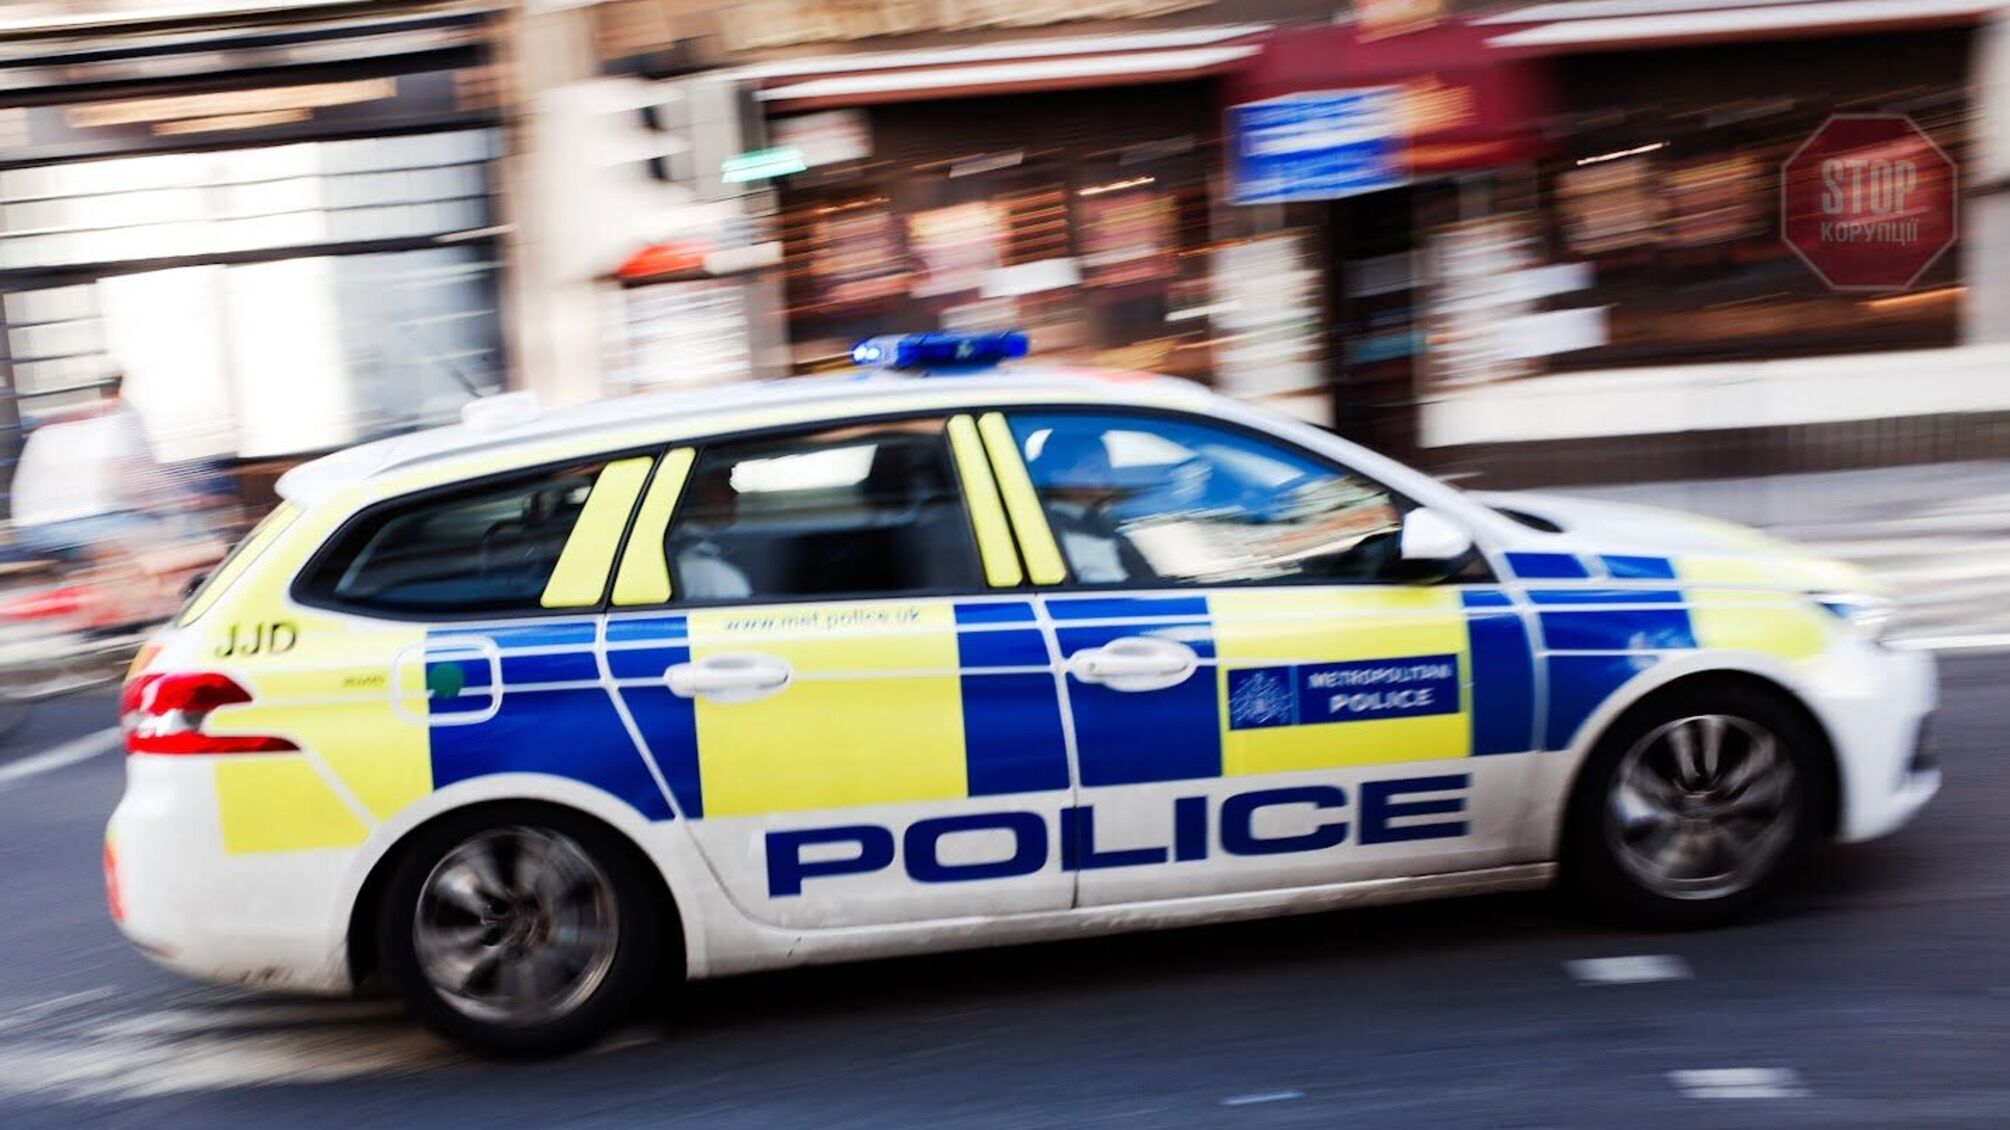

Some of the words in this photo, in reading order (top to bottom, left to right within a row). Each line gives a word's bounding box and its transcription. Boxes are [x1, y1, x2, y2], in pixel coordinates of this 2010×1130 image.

[214, 621, 298, 657] JJD
[1329, 687, 1435, 714] POLICE
[765, 773, 1470, 898] POLICE
